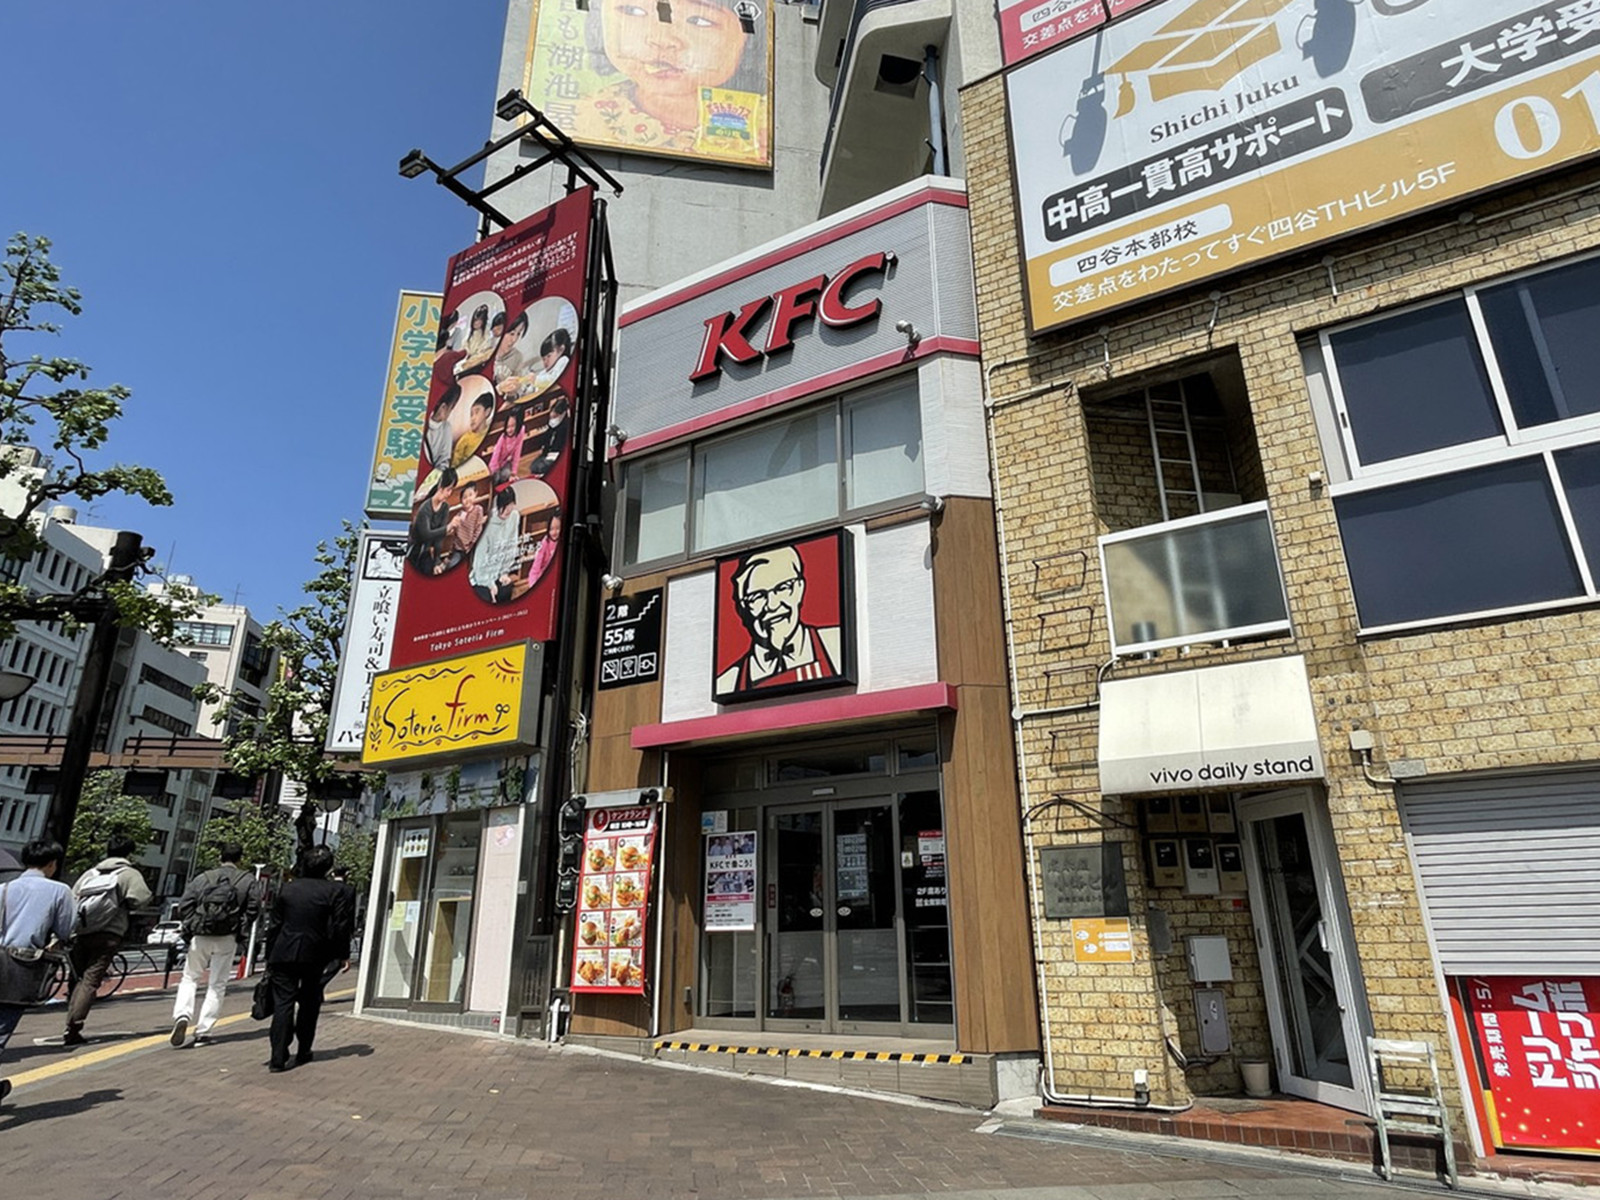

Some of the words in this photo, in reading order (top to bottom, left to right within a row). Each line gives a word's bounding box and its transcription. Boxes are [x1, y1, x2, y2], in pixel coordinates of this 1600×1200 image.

[1150, 96, 1233, 143] Shichi
[1234, 75, 1301, 112] Juku
[1046, 99, 1346, 231] 中高一貫高サポート
[1053, 161, 1457, 312] 交差点をわたってすぐ四谷THビル5F
[1077, 220, 1198, 274] 四谷本部校
[689, 251, 886, 382] KFC
[383, 298, 441, 460] 小学校受験
[430, 641, 452, 652] Tokyo
[454, 634, 483, 647] Soteria
[485, 628, 505, 639] Firm
[604, 627, 635, 646] 55席
[382, 687, 443, 744] Soteria
[1151, 767, 1193, 784] vivo
[1198, 762, 1248, 781] daily
[1253, 755, 1314, 776] stand
[1511, 982, 1570, 1088] ドリーム
[1544, 980, 1600, 1089] ジャンボ
